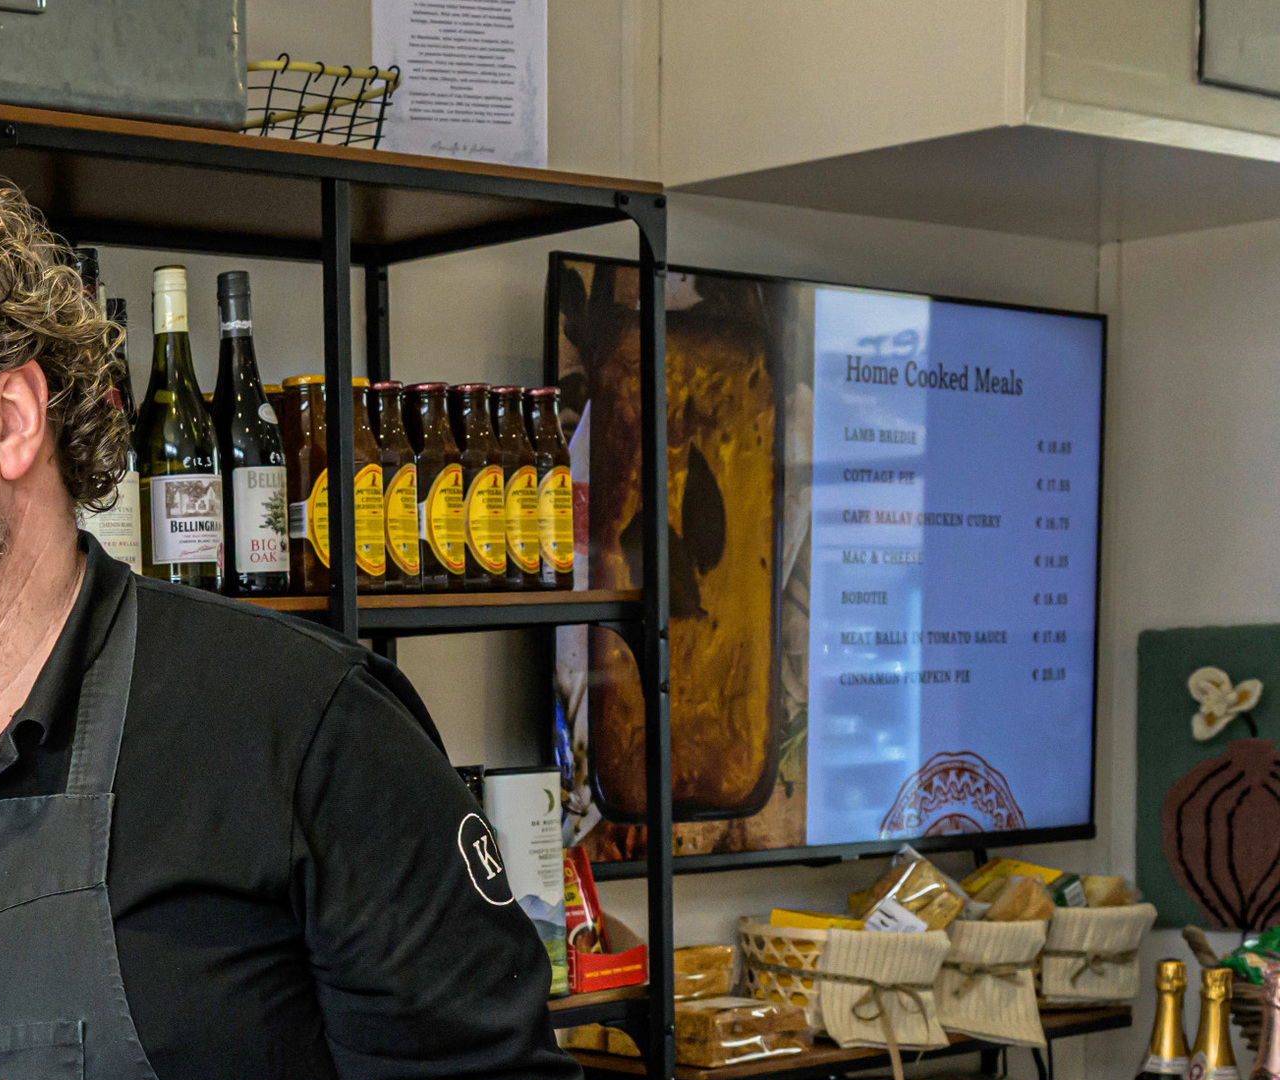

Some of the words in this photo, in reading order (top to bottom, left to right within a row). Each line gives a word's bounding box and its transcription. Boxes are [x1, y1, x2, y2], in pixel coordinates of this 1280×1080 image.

[846, 355, 899, 386] Home
[904, 360, 969, 392] Cooked
[974, 365, 1023, 396] Meals
[844, 427, 875, 443] LAMB
[879, 428, 918, 446] BREDIE
[843, 468, 895, 484] COTTAGE
[898, 470, 916, 486] PIE
[842, 509, 871, 525] CAPE
[875, 510, 913, 526] MALAY
[916, 512, 964, 528] CHICKEN
[966, 513, 1002, 529] CURRY
[251, 538, 277, 552] BIG
[249, 551, 278, 563] OAK
[841, 550, 867, 566] MAC
[870, 550, 879, 565] &
[882, 550, 924, 565] CHEESE
[840, 590, 888, 606] BOBOTIE
[840, 630, 872, 646] MEAT
[875, 630, 909, 646] BALLS
[926, 630, 972, 645] TOMATO
[974, 630, 1008, 644] SAUCE
[840, 671, 900, 686] CINNAMON
[903, 669, 953, 685] PUMPKIN
[954, 669, 972, 684] PIE
[472, 834, 503, 881] K
